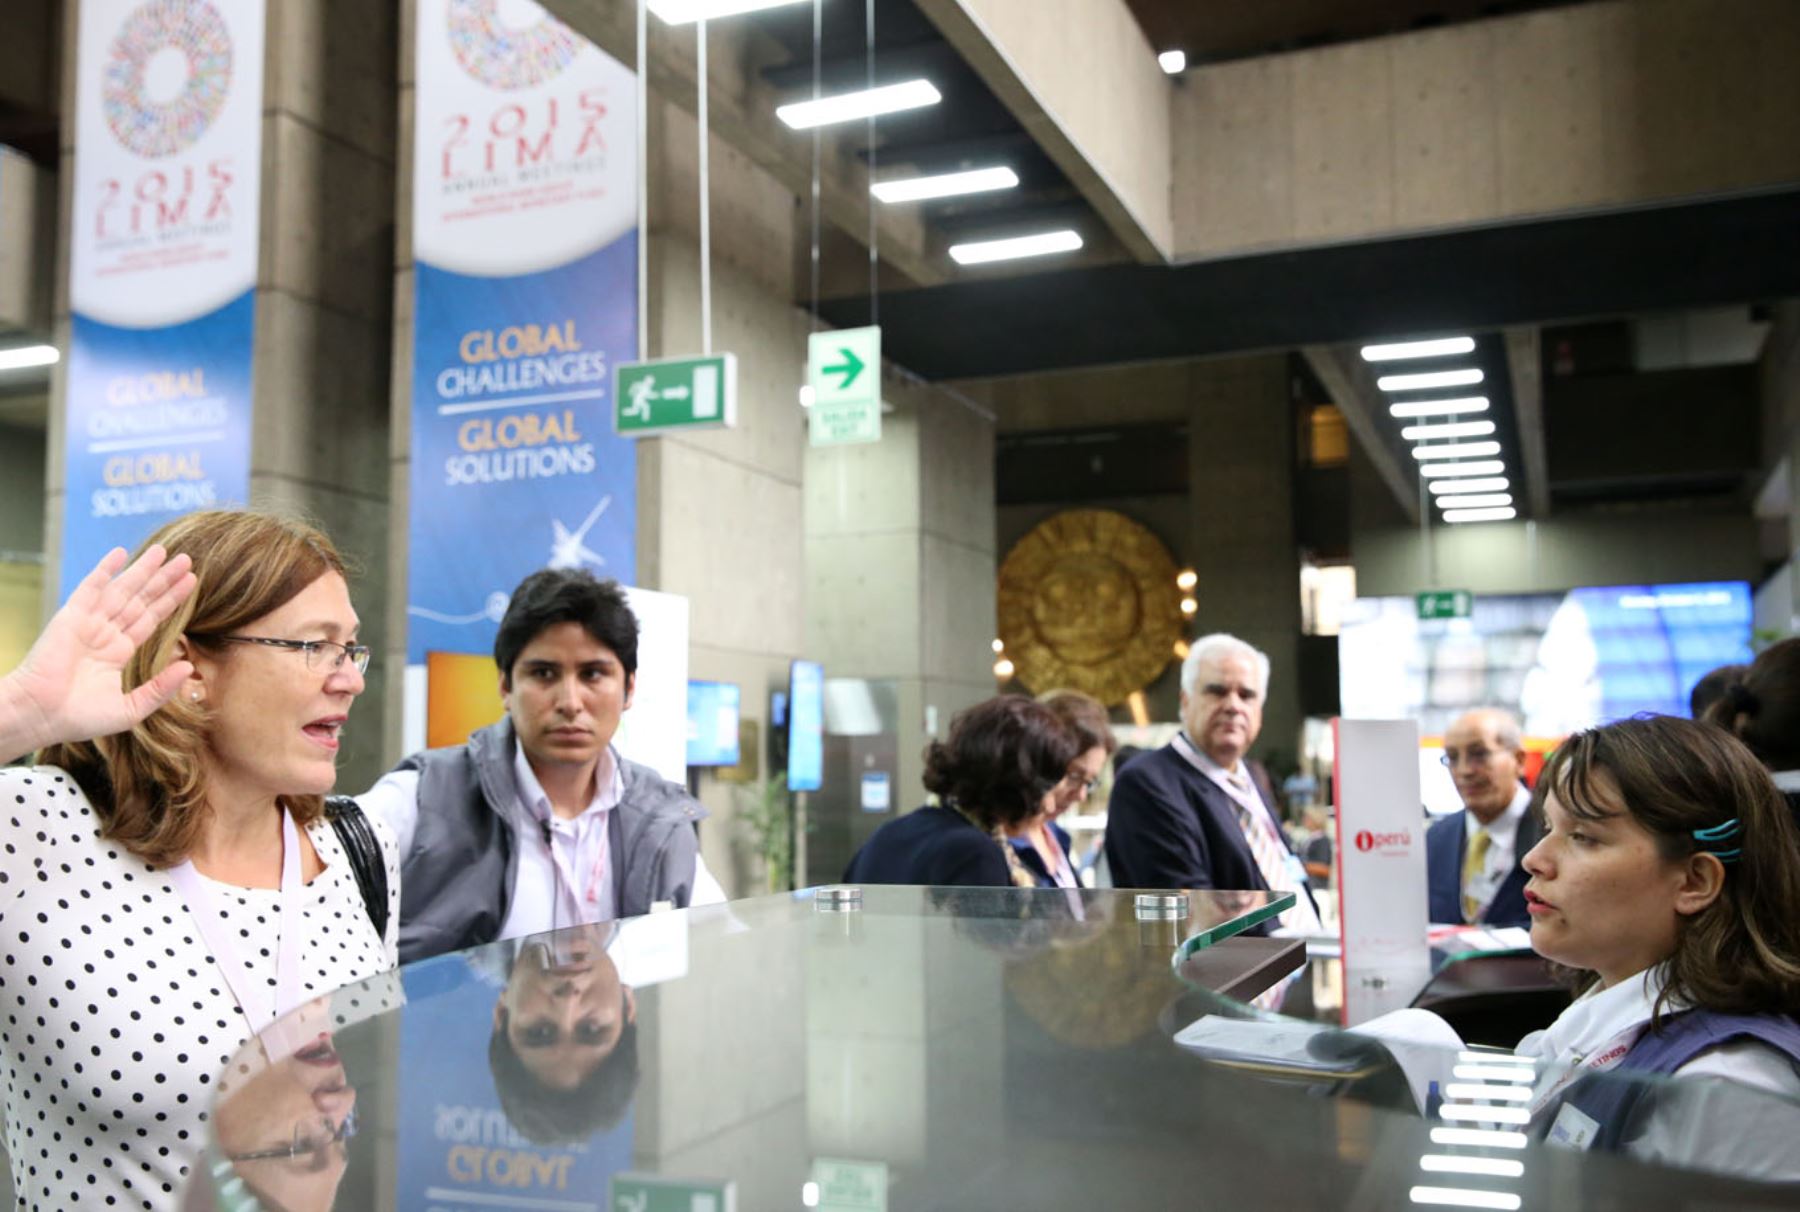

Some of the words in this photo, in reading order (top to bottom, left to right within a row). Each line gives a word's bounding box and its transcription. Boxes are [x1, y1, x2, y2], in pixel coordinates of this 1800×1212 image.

[443, 88, 608, 149] 2015
[441, 120, 608, 181] LIMA
[97, 159, 234, 209] 2015
[460, 320, 583, 364] GLOBAL
[107, 368, 207, 406] GLOBAL
[436, 350, 607, 399] CHALLENGES
[458, 411, 582, 452] GLOBAL
[103, 451, 206, 488] GLOBAL
[445, 443, 596, 485] SOLUTIONS
[90, 480, 218, 518] SOLUTIONS
